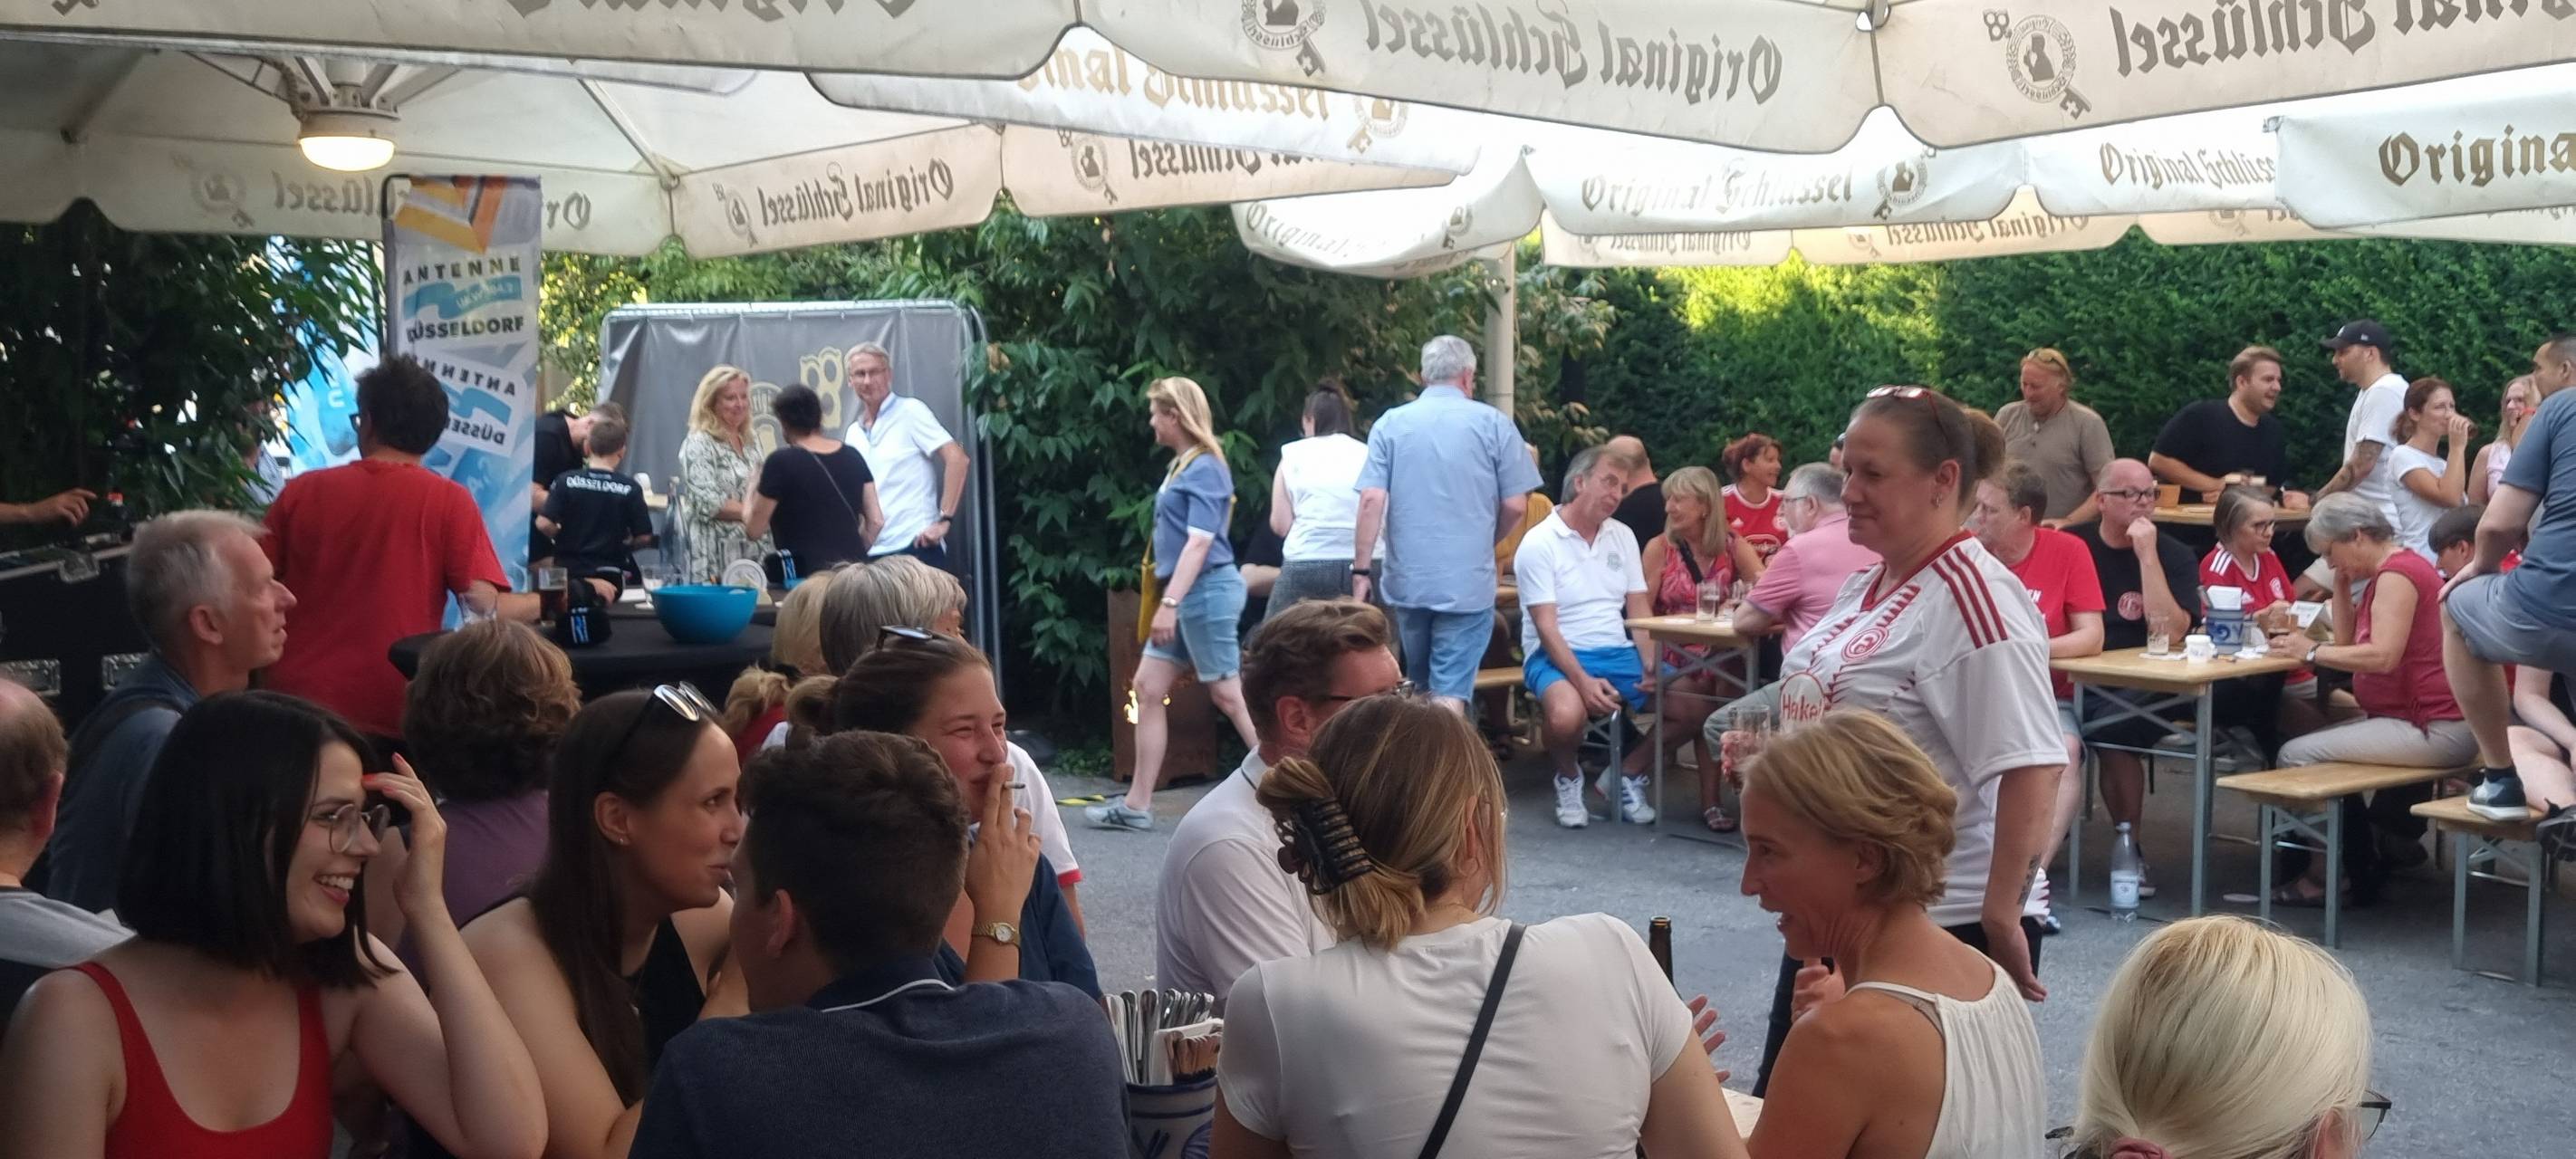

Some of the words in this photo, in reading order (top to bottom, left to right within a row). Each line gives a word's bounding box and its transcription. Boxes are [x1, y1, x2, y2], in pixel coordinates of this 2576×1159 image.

[2100, 142, 2205, 190] Original
[2197, 148, 2276, 189] Schlüss
[2379, 124, 2576, 187] Origina
[1581, 172, 1713, 217] Original
[403, 256, 522, 285] ANTENNE
[406, 316, 524, 343] DÜSSELDORF
[566, 475, 632, 495] DÜSSELDORF
